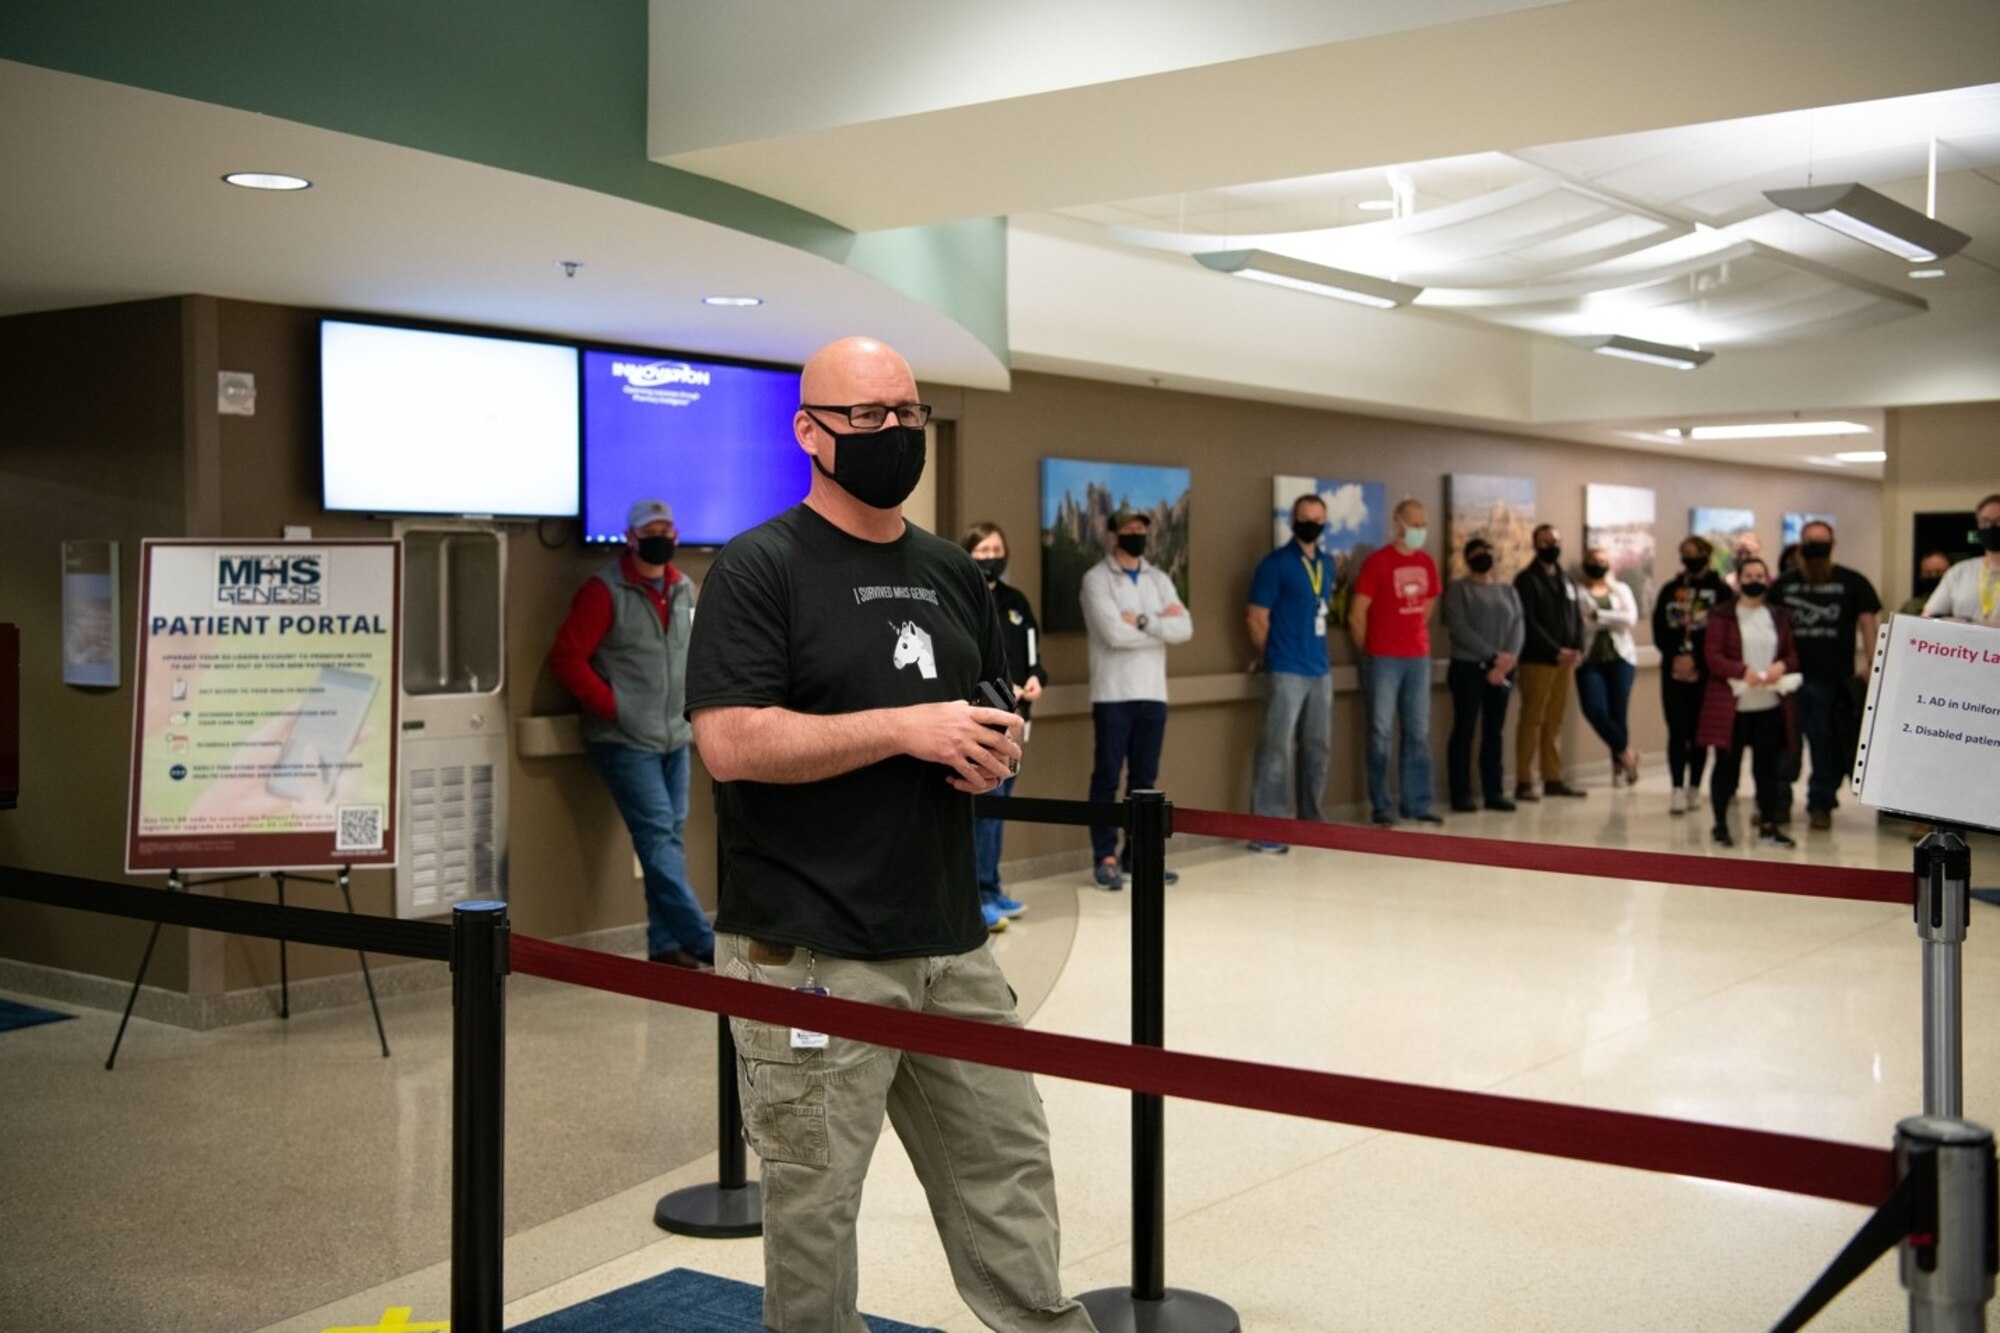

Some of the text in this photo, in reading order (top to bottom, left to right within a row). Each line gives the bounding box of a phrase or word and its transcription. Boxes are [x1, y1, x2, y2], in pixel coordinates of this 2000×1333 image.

[219, 559, 321, 585] MHS
[218, 586, 321, 605] GENESIS
[858, 586, 893, 602] SURVIVED
[152, 614, 386, 636] PATIENT PORTAL
[1916, 694, 1926, 704] 1.
[1928, 696, 1946, 707] AD
[1948, 699, 1959, 709] in
[1902, 723, 1912, 733] 2.
[1915, 725, 1963, 741] Disabled
